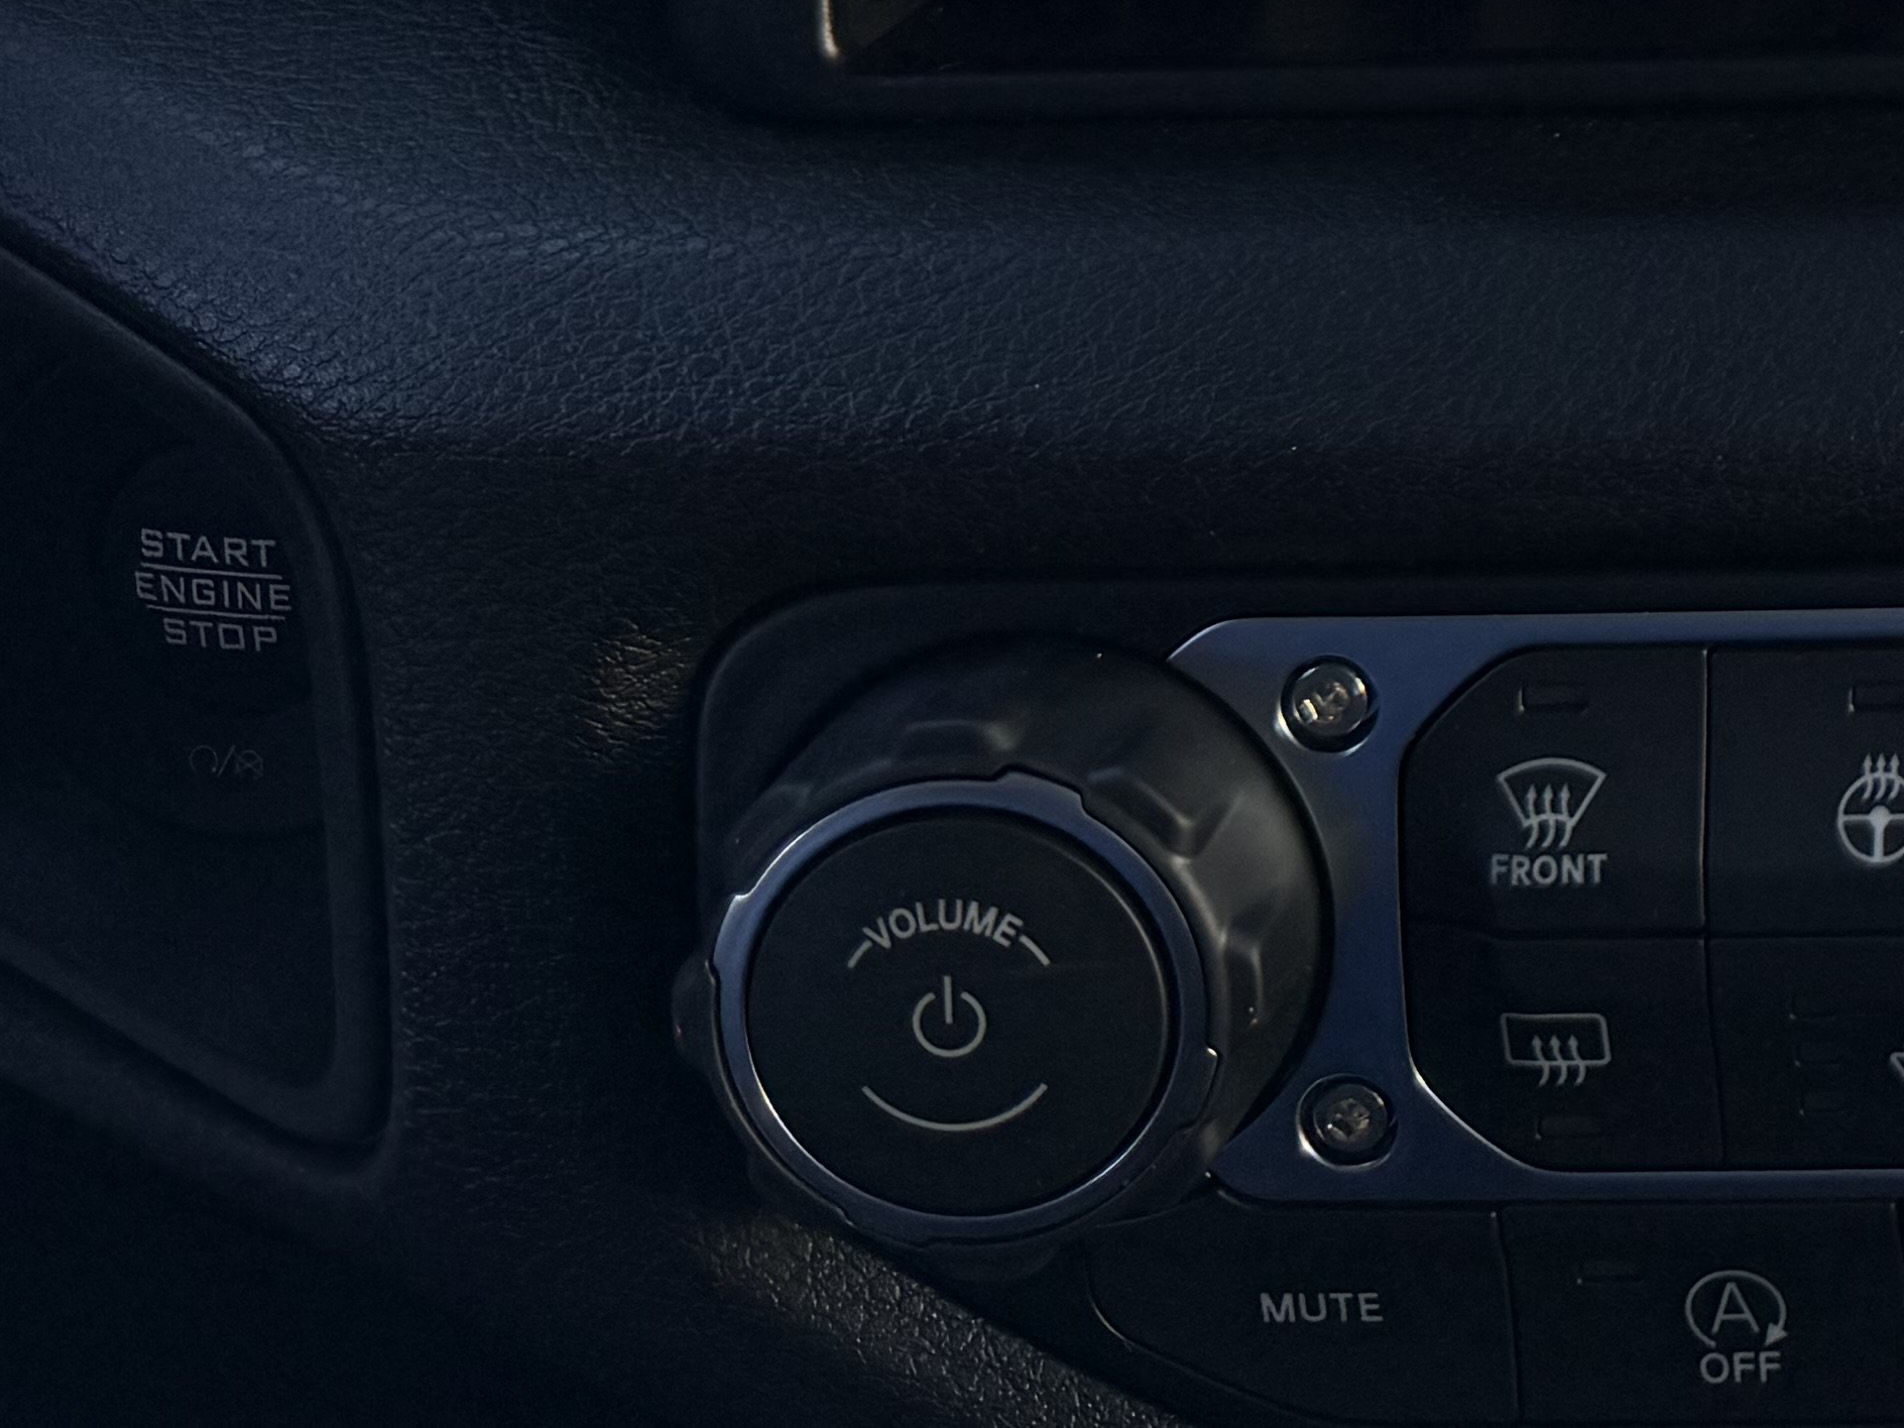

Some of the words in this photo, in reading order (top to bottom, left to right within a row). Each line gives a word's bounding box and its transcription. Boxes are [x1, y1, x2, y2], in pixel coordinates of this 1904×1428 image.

[140, 528, 275, 569] START
[135, 572, 291, 611] ENGINE
[163, 617, 277, 651] STOP
[1490, 853, 1608, 887] FRONT
[861, 898, 1025, 950] VOLUME
[1261, 1293, 1384, 1325] MUTE
[1700, 1352, 1782, 1383] OFF
